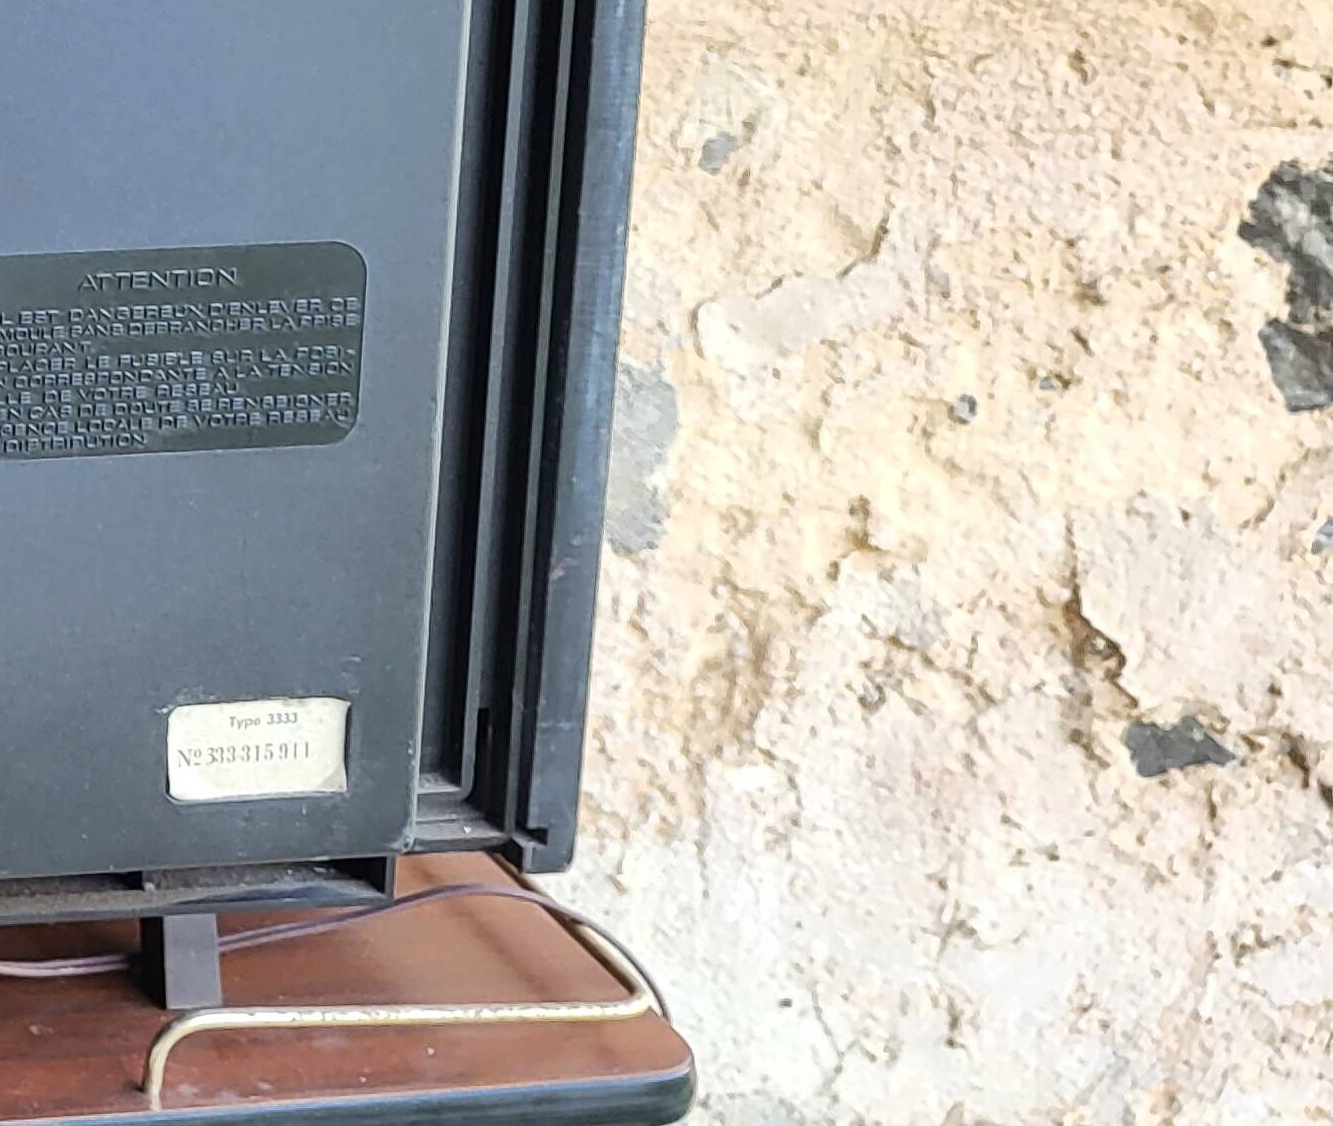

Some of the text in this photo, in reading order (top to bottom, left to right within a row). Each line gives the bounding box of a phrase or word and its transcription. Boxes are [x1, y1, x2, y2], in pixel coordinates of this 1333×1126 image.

[78, 267, 238, 291] ATTENTION
[18, 308, 62, 324] EST
[68, 303, 205, 323] DANGEREUX
[70, 322, 124, 338] SANS
[128, 317, 267, 336] DEBRANCHER
[85, 355, 110, 370] LE
[118, 350, 203, 367] FUSIBLE
[212, 348, 254, 364] SUR
[261, 347, 290, 362] LA
[13, 367, 208, 389] CORRESPONDANTE
[213, 366, 229, 380] A
[235, 364, 262, 378] LA
[267, 361, 354, 378] TENSION
[43, 389, 72, 404] DE
[78, 385, 148, 401] VOTRE
[156, 382, 239, 398] RESEAU
[29, 405, 72, 421] CAS
[78, 403, 110, 417] DE
[114, 399, 182, 416] DOUTE
[187, 398, 212, 412] SE
[218, 392, 352, 410] RENSEIGNER
[75, 416, 153, 434] LOCALE
[158, 414, 189, 429] DE
[194, 412, 262, 428] VOTRE
[266, 408, 350, 425] RESEAU
[4, 433, 147, 454] DISTRIBUTION
[229, 712, 299, 732] Type 3333
